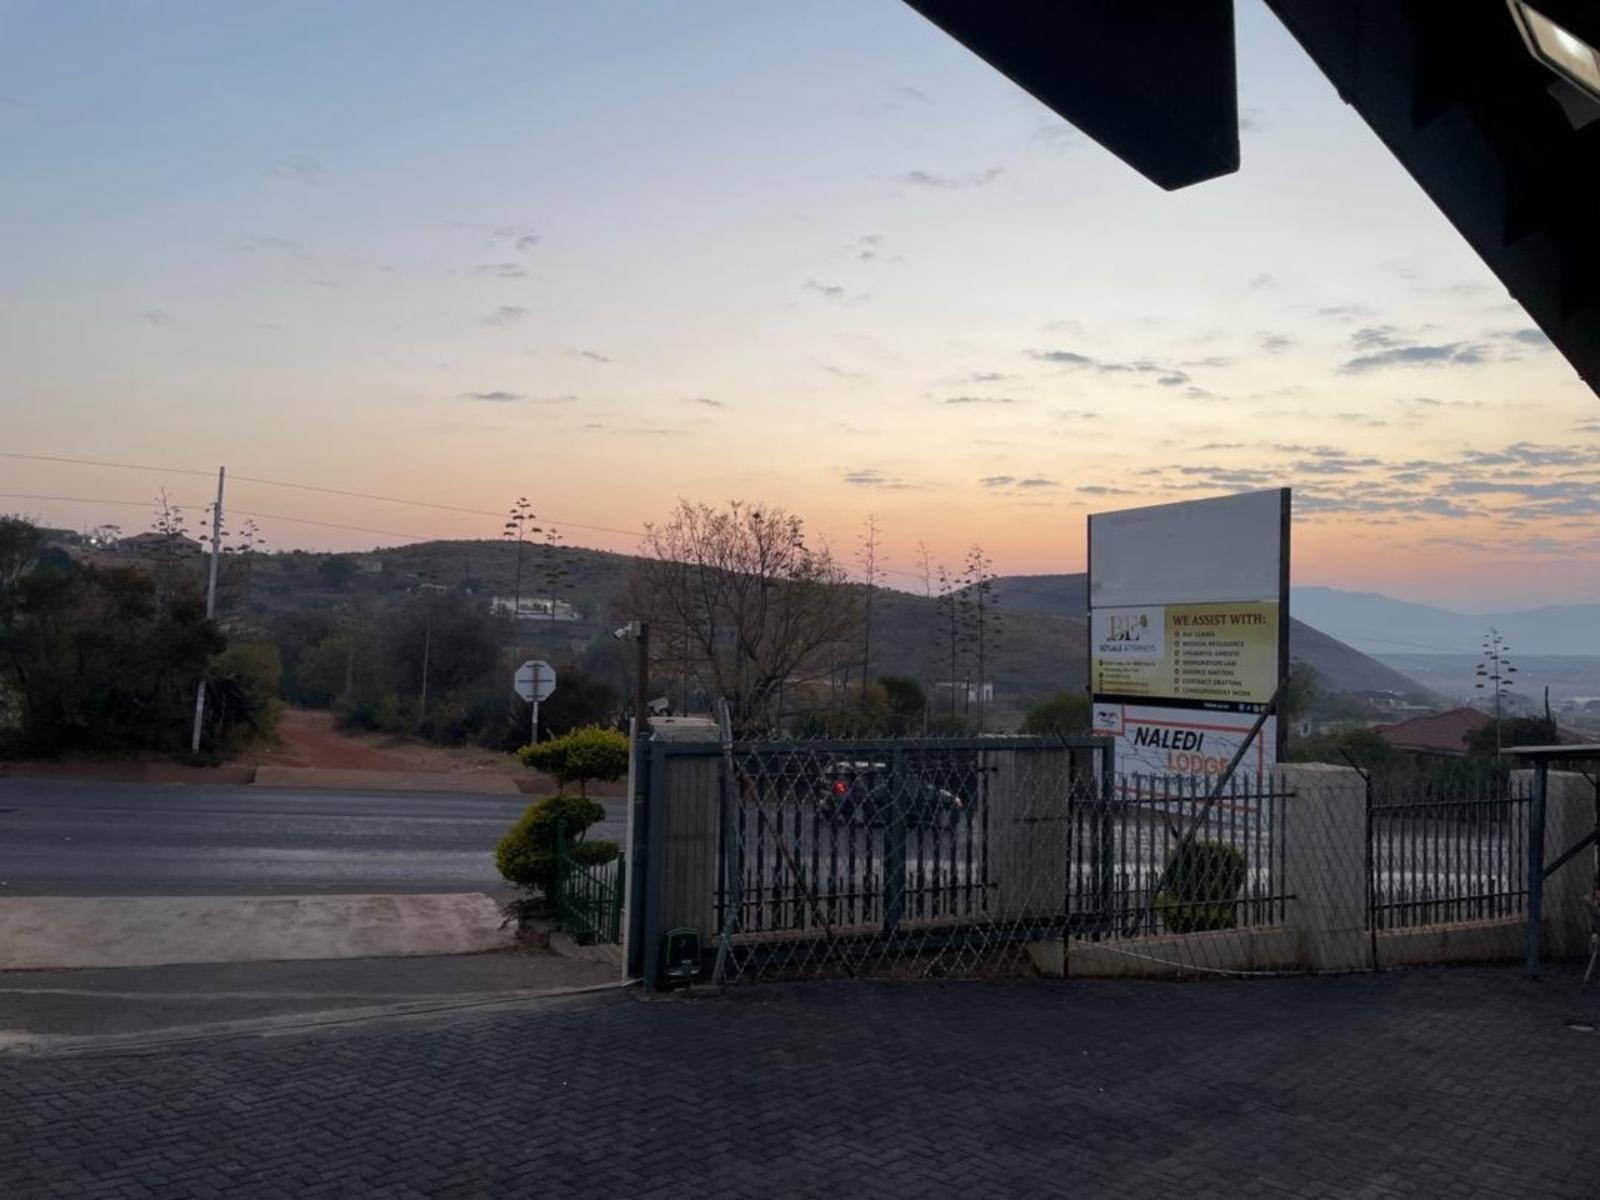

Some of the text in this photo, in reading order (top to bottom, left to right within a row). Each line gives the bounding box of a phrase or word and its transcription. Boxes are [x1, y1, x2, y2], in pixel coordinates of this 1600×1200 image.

[1172, 613, 1267, 626] WE ASSIST WITH:
[1134, 726, 1205, 752] NALEDI
[1167, 749, 1230, 775] LODGE
